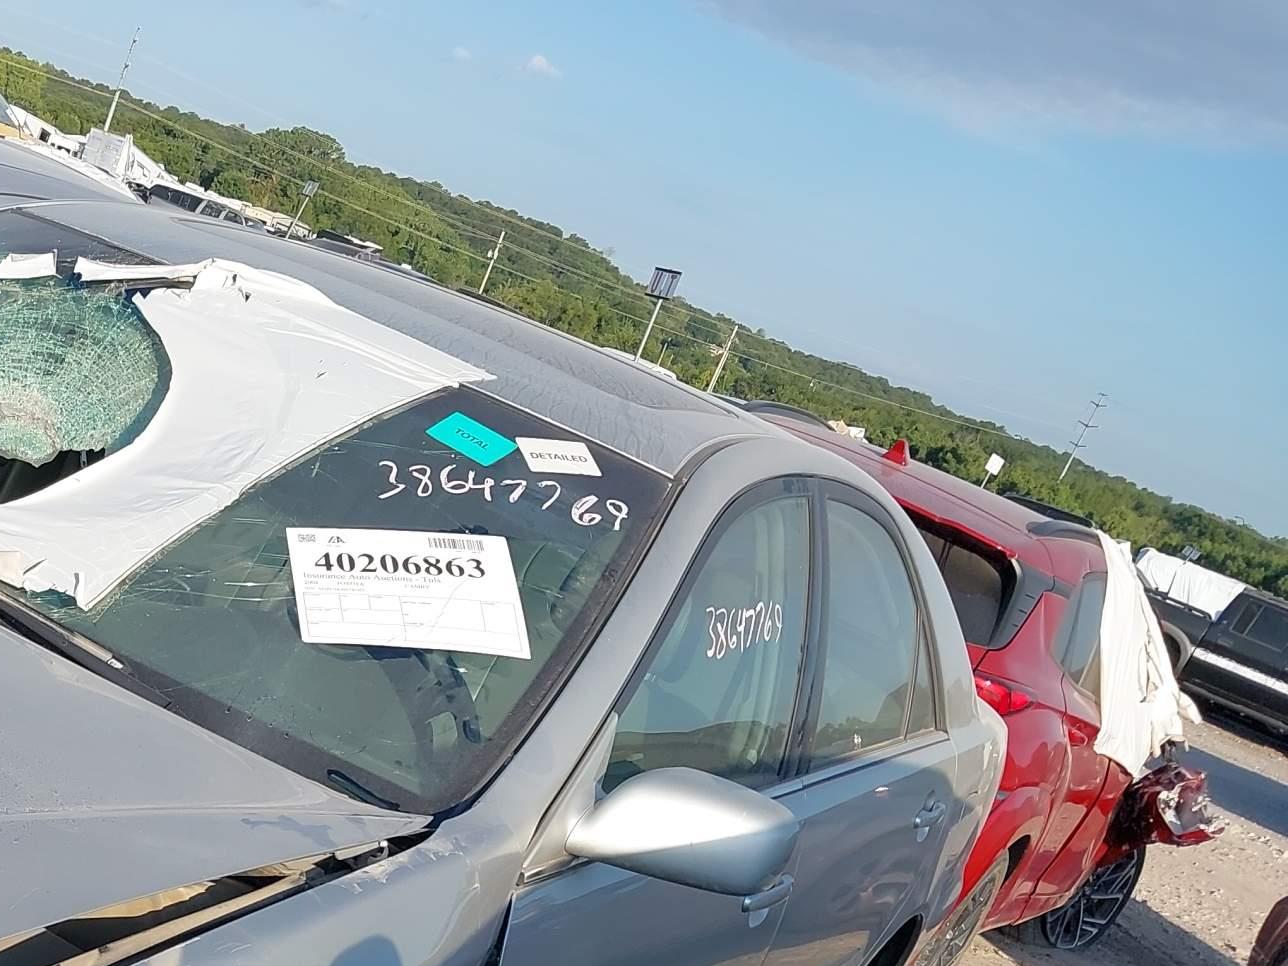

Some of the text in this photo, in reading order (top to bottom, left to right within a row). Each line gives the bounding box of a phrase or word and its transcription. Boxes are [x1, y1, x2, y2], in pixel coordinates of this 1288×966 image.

[455, 428, 489, 451] TOTAL
[530, 451, 588, 463] DETAILED
[315, 551, 486, 579] 40206863
[303, 572, 346, 580] Insurance
[373, 574, 413, 583] Auctions
